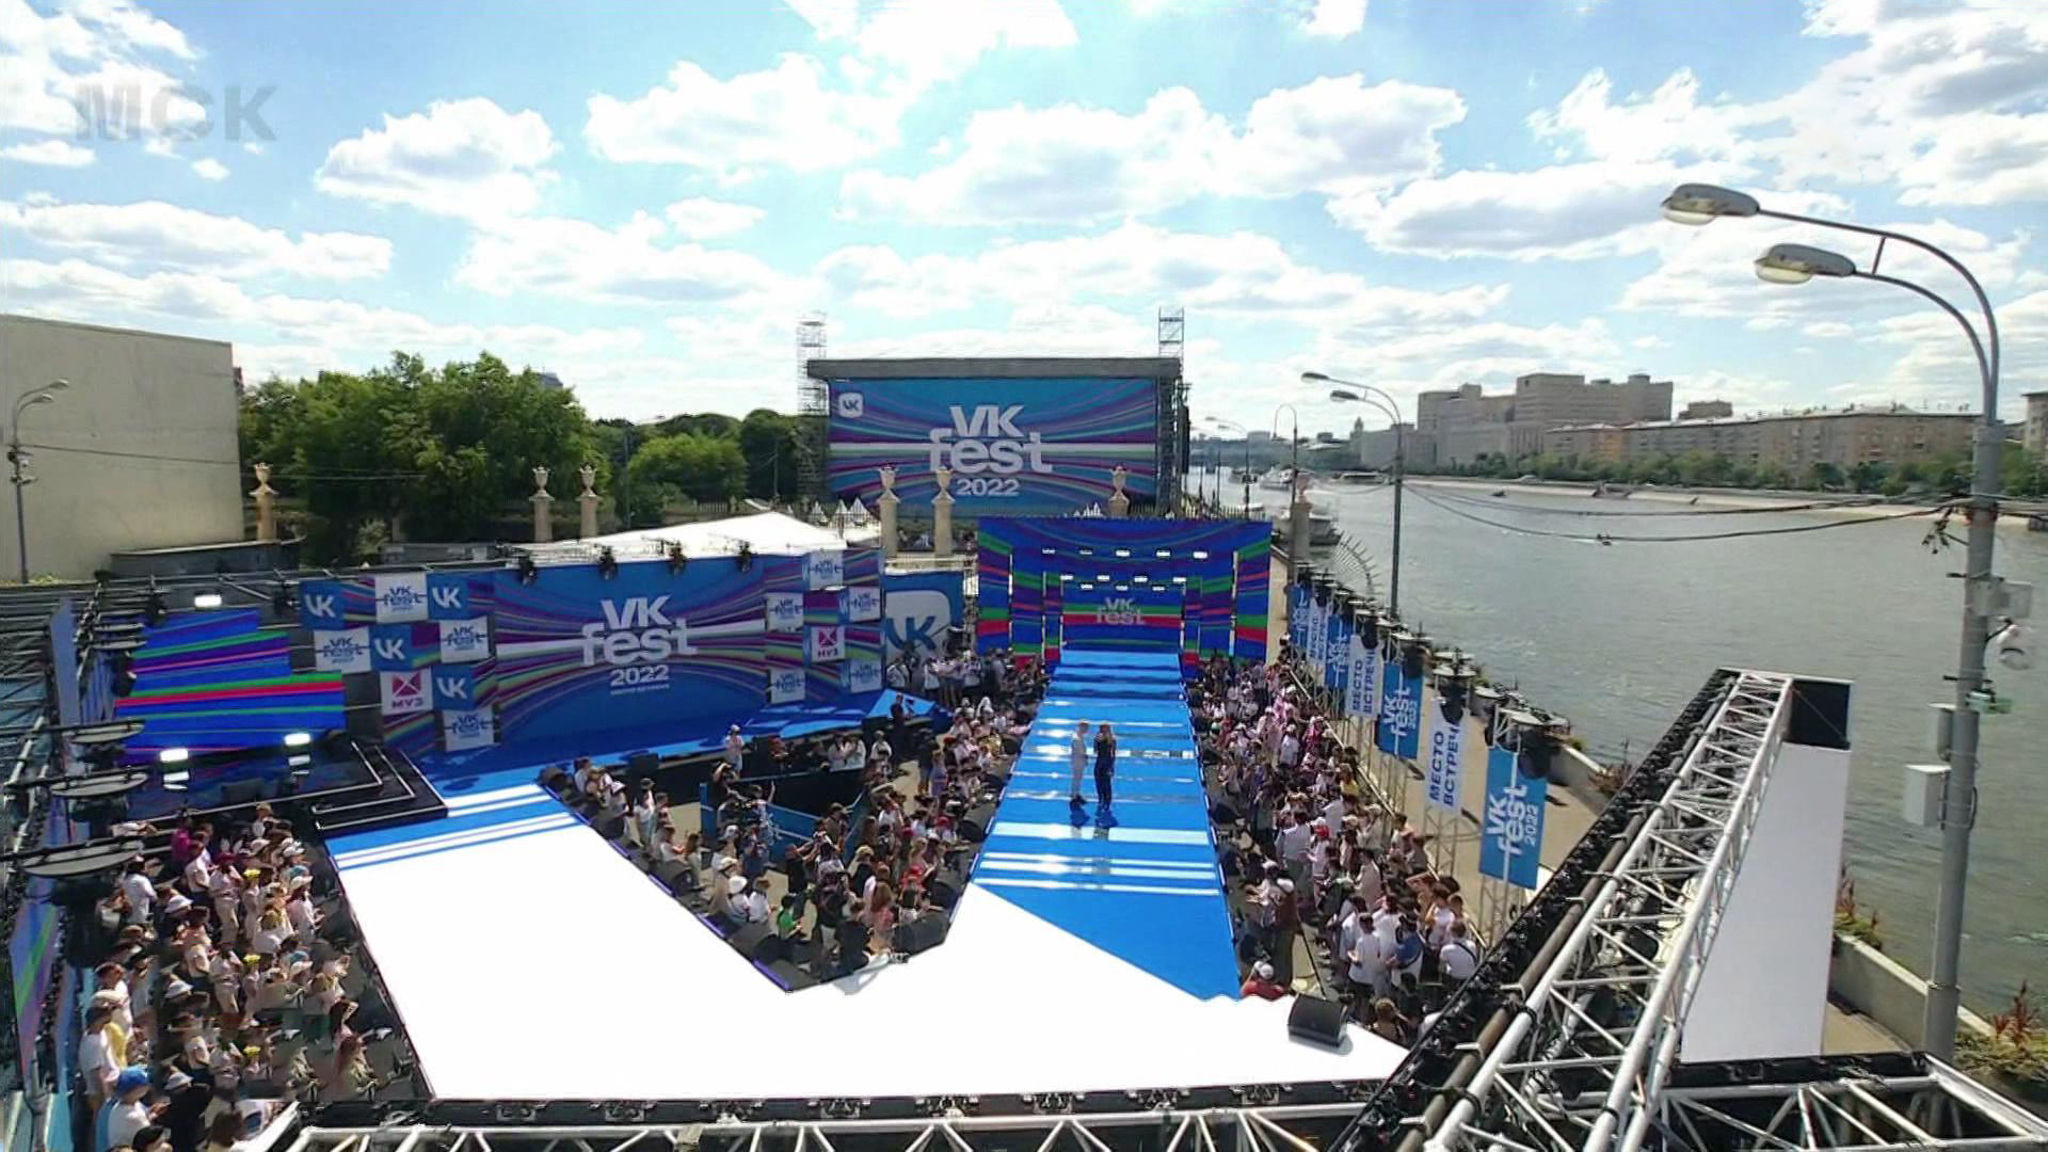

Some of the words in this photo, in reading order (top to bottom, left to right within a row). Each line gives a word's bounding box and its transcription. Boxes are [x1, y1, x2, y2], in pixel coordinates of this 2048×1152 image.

[843, 399, 859, 411] VK
[950, 404, 1024, 437] VK
[930, 428, 1052, 474] fest
[956, 478, 1020, 497] 2022
[304, 594, 336, 618] VK
[431, 587, 462, 609] VK
[601, 594, 672, 630] VK
[1105, 597, 1136, 611] VK
[1097, 606, 1144, 625] fest
[374, 640, 406, 660] VK
[582, 617, 698, 666] fest
[436, 677, 468, 699] VK
[610, 664, 669, 686] 2022
[1353, 660, 1363, 712] МЕСТО
[1383, 695, 1397, 724] VK
[1390, 687, 1411, 737] fest
[1429, 731, 1445, 802] МЕСТО
[1486, 793, 1508, 835] VK
[1497, 784, 1528, 855] fest
[1524, 803, 1539, 848] 2022
